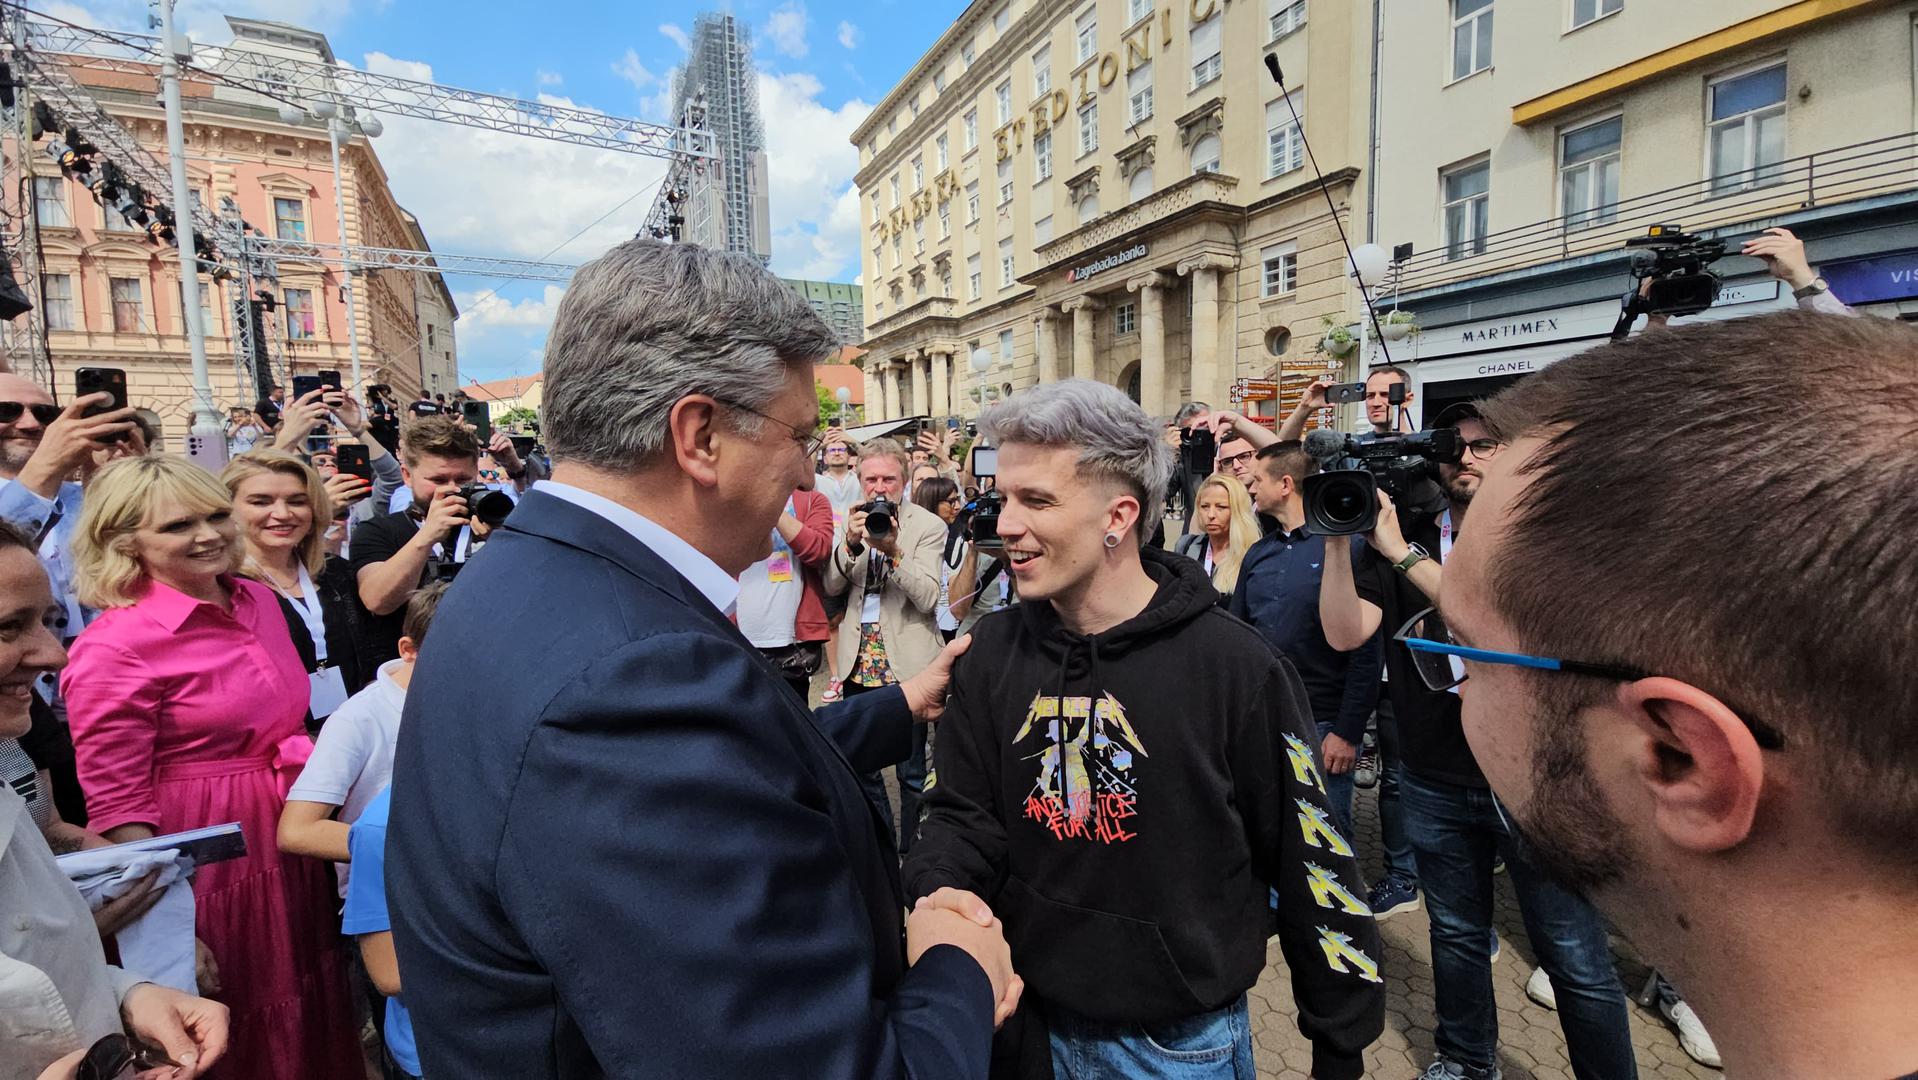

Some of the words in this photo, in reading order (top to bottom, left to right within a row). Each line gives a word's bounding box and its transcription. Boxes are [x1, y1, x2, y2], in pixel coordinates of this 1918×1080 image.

[1119, 244, 1146, 264] banka
[1462, 318, 1558, 343] MARTIMEX
[1478, 361, 1534, 374] CHANEL
